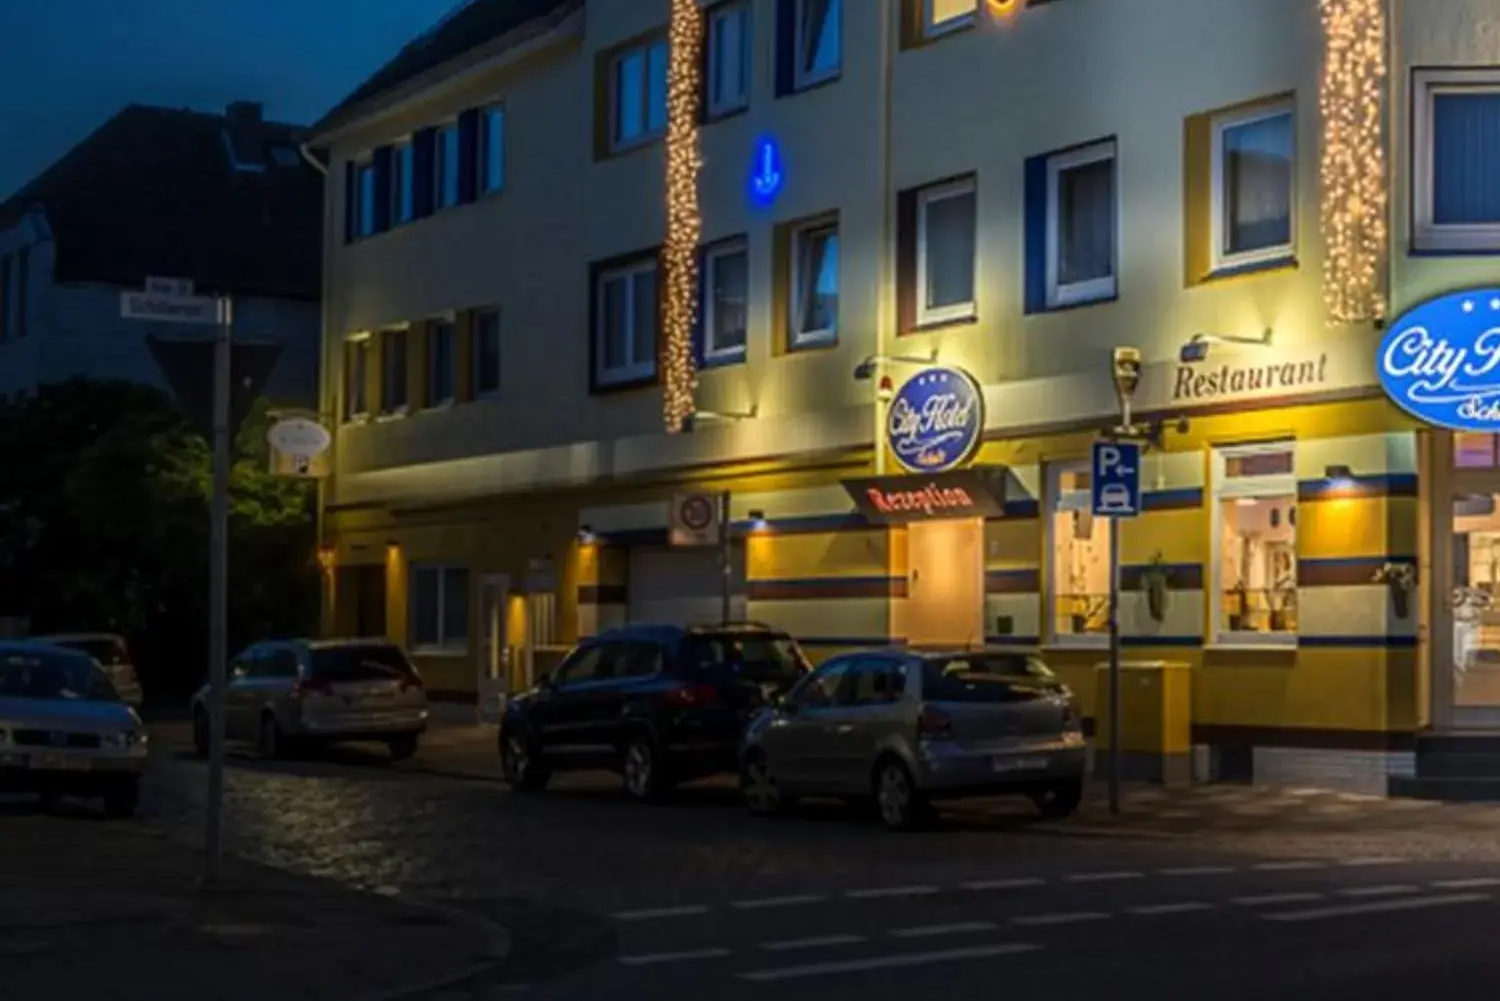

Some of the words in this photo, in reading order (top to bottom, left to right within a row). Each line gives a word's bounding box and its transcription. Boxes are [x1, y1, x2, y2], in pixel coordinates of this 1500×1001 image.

[1174, 353, 1327, 399] Restaurant
[1384, 326, 1467, 391] City
[1099, 447, 1121, 476] P
[867, 482, 974, 515] Rezeption
